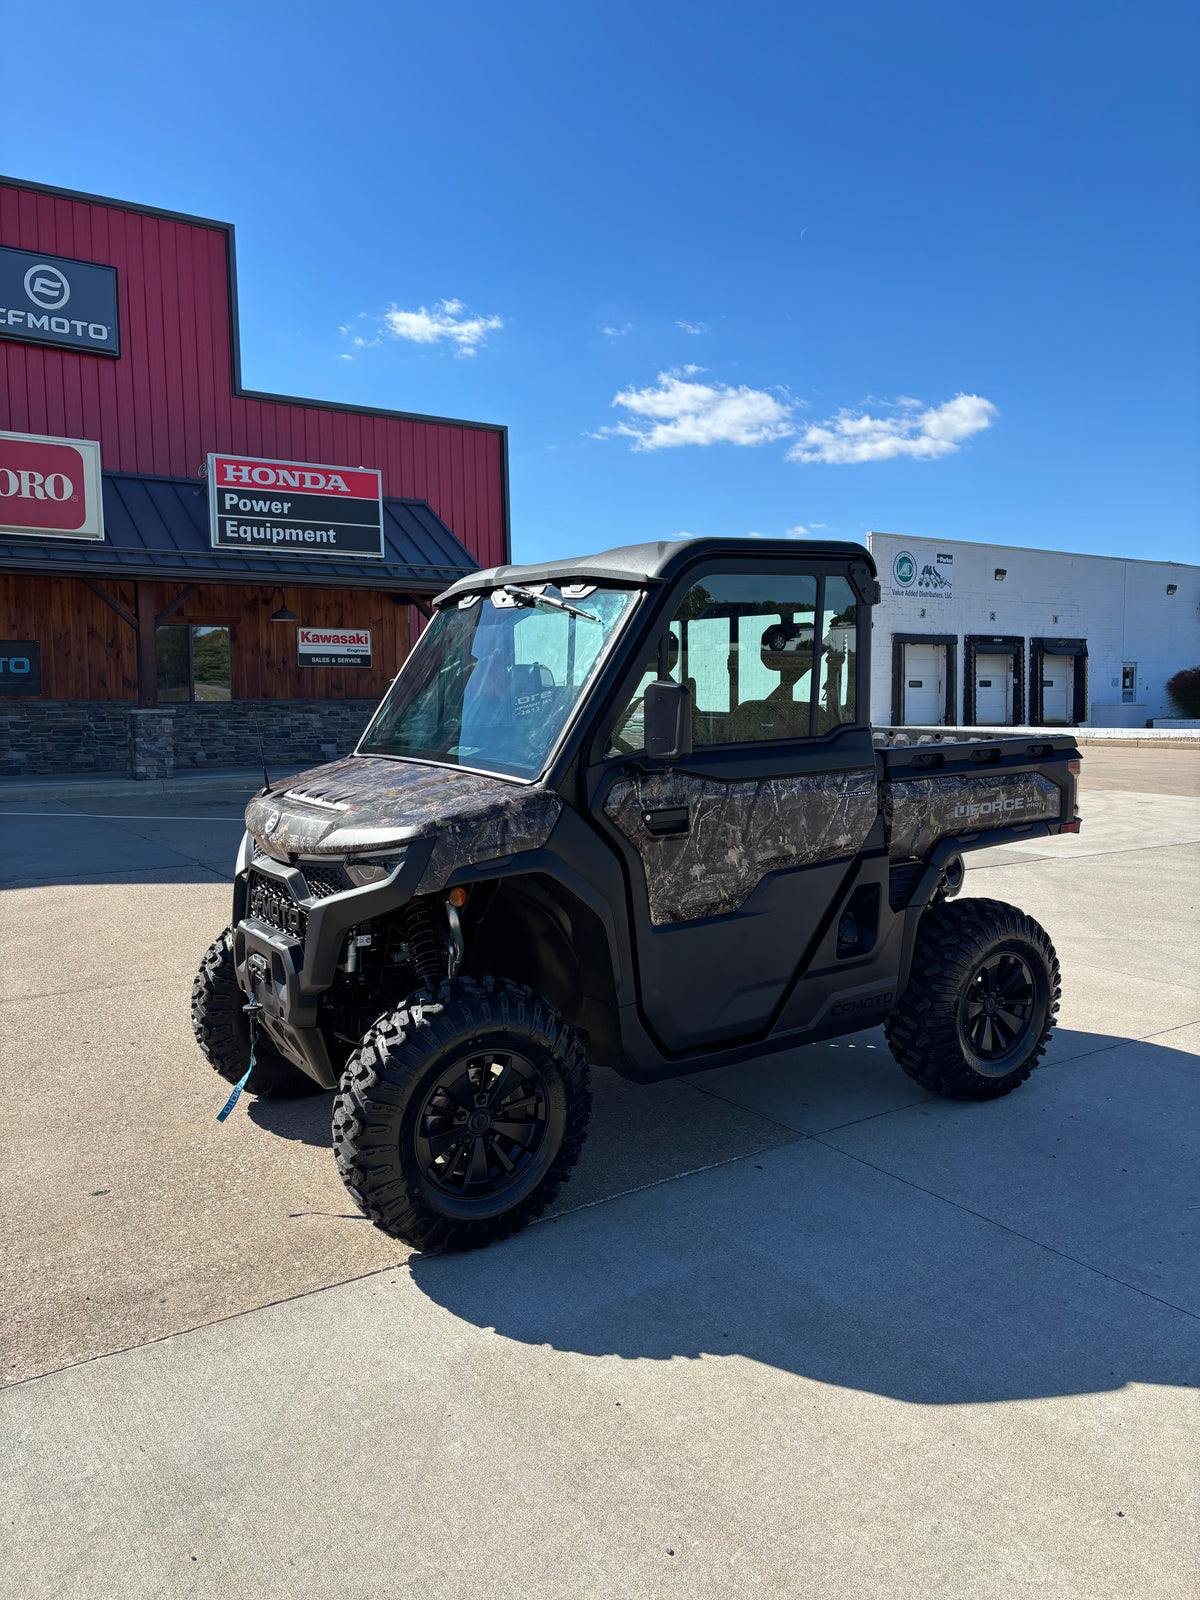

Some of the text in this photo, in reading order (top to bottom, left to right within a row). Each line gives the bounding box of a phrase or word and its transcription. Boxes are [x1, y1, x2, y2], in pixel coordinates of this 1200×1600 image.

[223, 464, 350, 492] HONDA
[224, 493, 292, 514] Power
[225, 520, 336, 543] Equipment
[920, 608, 926, 617] 3
[990, 612, 996, 620] 2
[300, 631, 369, 644] Kawasaki
[955, 798, 1024, 818] UFORCE
[832, 992, 893, 1016] CFMOTO
